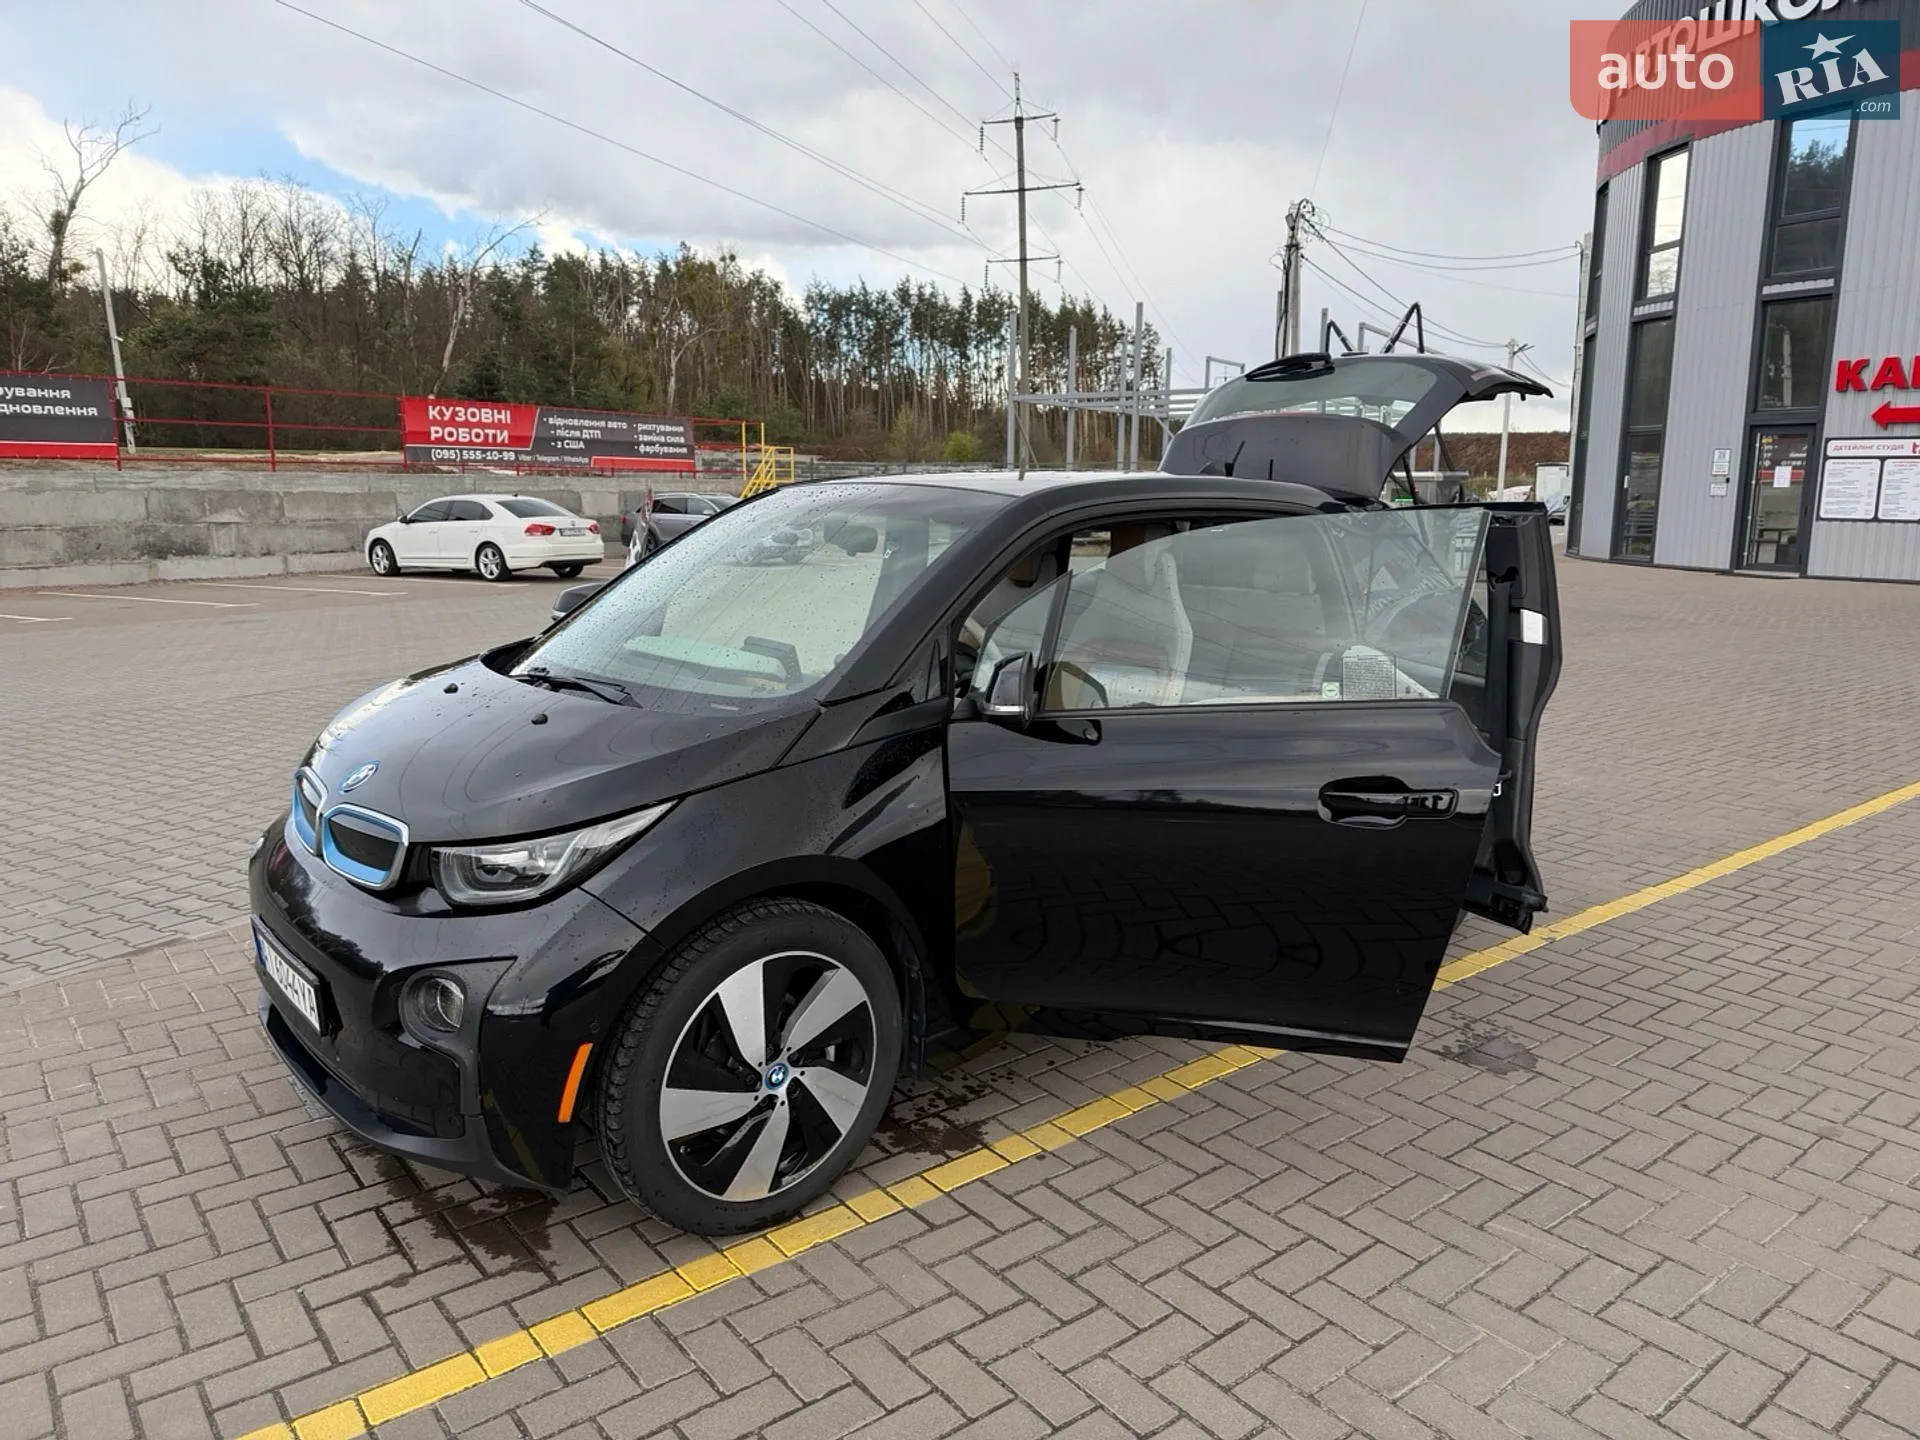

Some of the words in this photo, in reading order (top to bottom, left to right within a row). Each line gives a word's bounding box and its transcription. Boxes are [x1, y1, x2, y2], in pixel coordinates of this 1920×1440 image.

[428, 405, 511, 424] КУЗОВНІ
[548, 415, 606, 428] відновлення
[607, 420, 628, 429] авто
[430, 426, 509, 444] РОБОТИ
[556, 428, 580, 437] після
[582, 429, 601, 439] ДТП
[638, 433, 665, 443] заміна
[563, 440, 585, 449] США
[638, 443, 688, 455] фарбування
[431, 448, 460, 461] (095)
